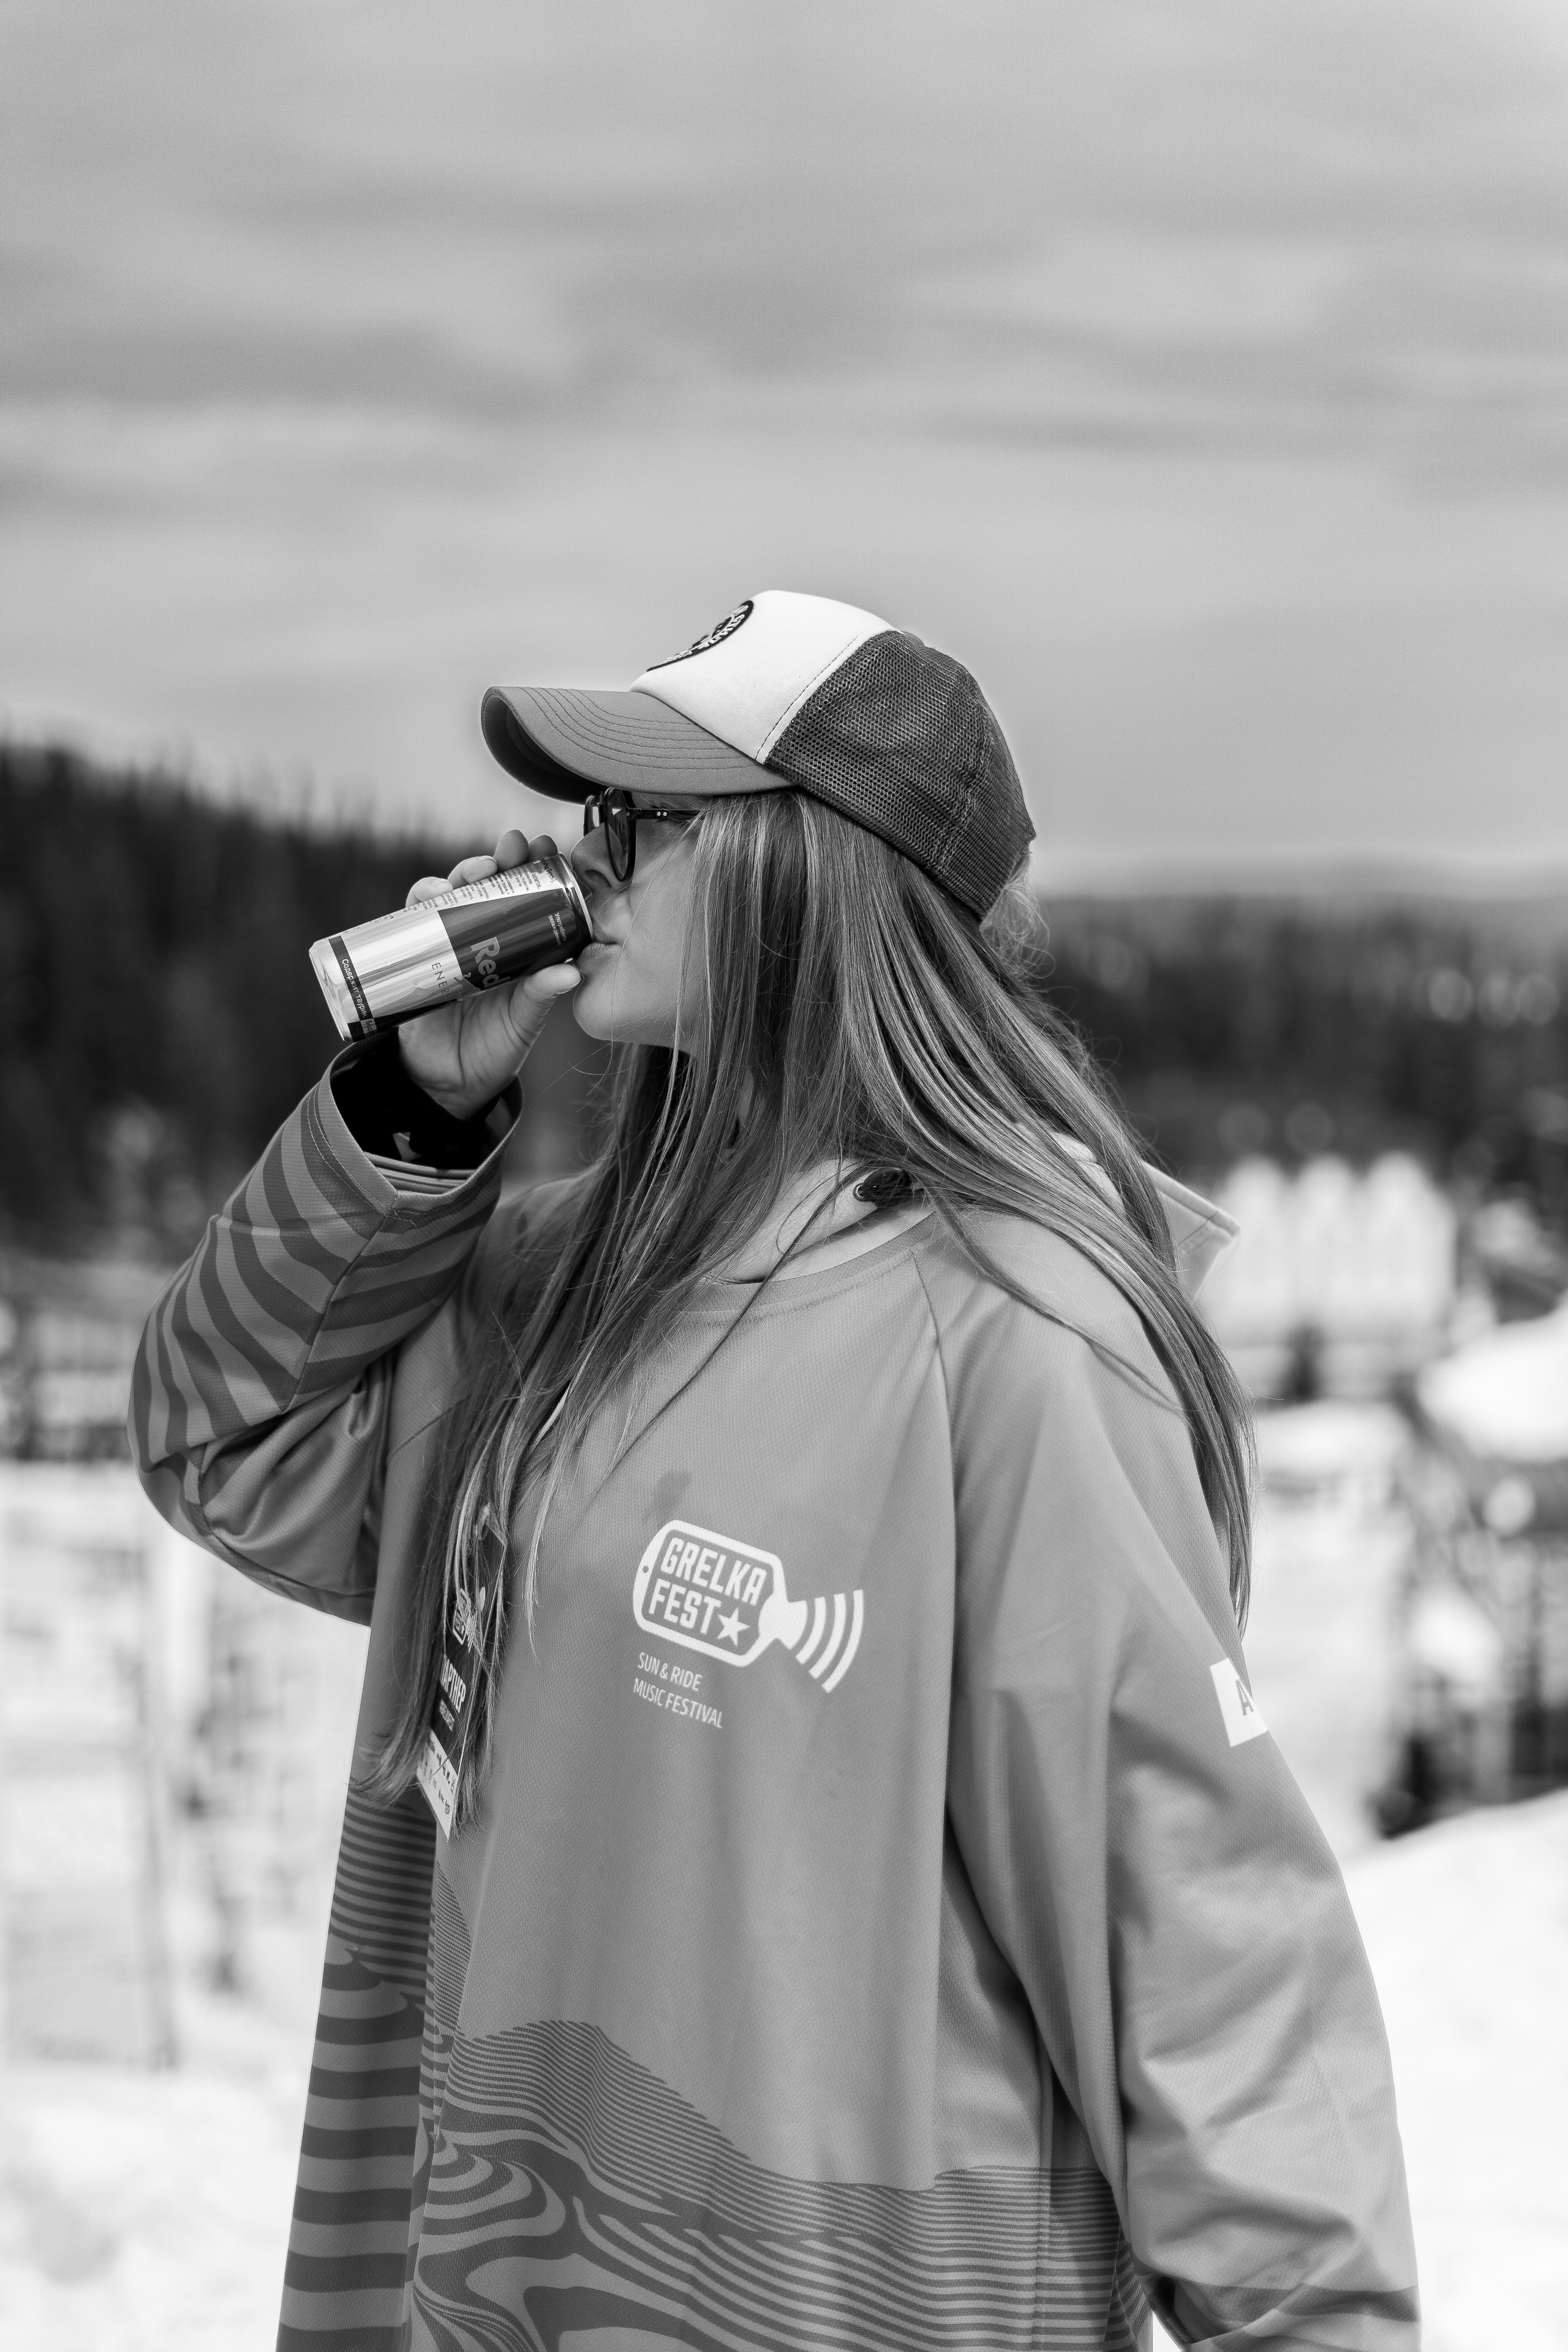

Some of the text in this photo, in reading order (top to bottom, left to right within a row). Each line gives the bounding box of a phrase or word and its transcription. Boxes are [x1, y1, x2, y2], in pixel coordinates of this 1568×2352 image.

[342, 959, 360, 993] Содержит
[470, 936, 511, 989] Red
[660, 1537, 767, 1606] GRELKA
[648, 1578, 721, 1635] FEST
[637, 1651, 703, 1692] SUN & RIDE
[633, 1677, 723, 1728] MUSIC FESTIVAL
